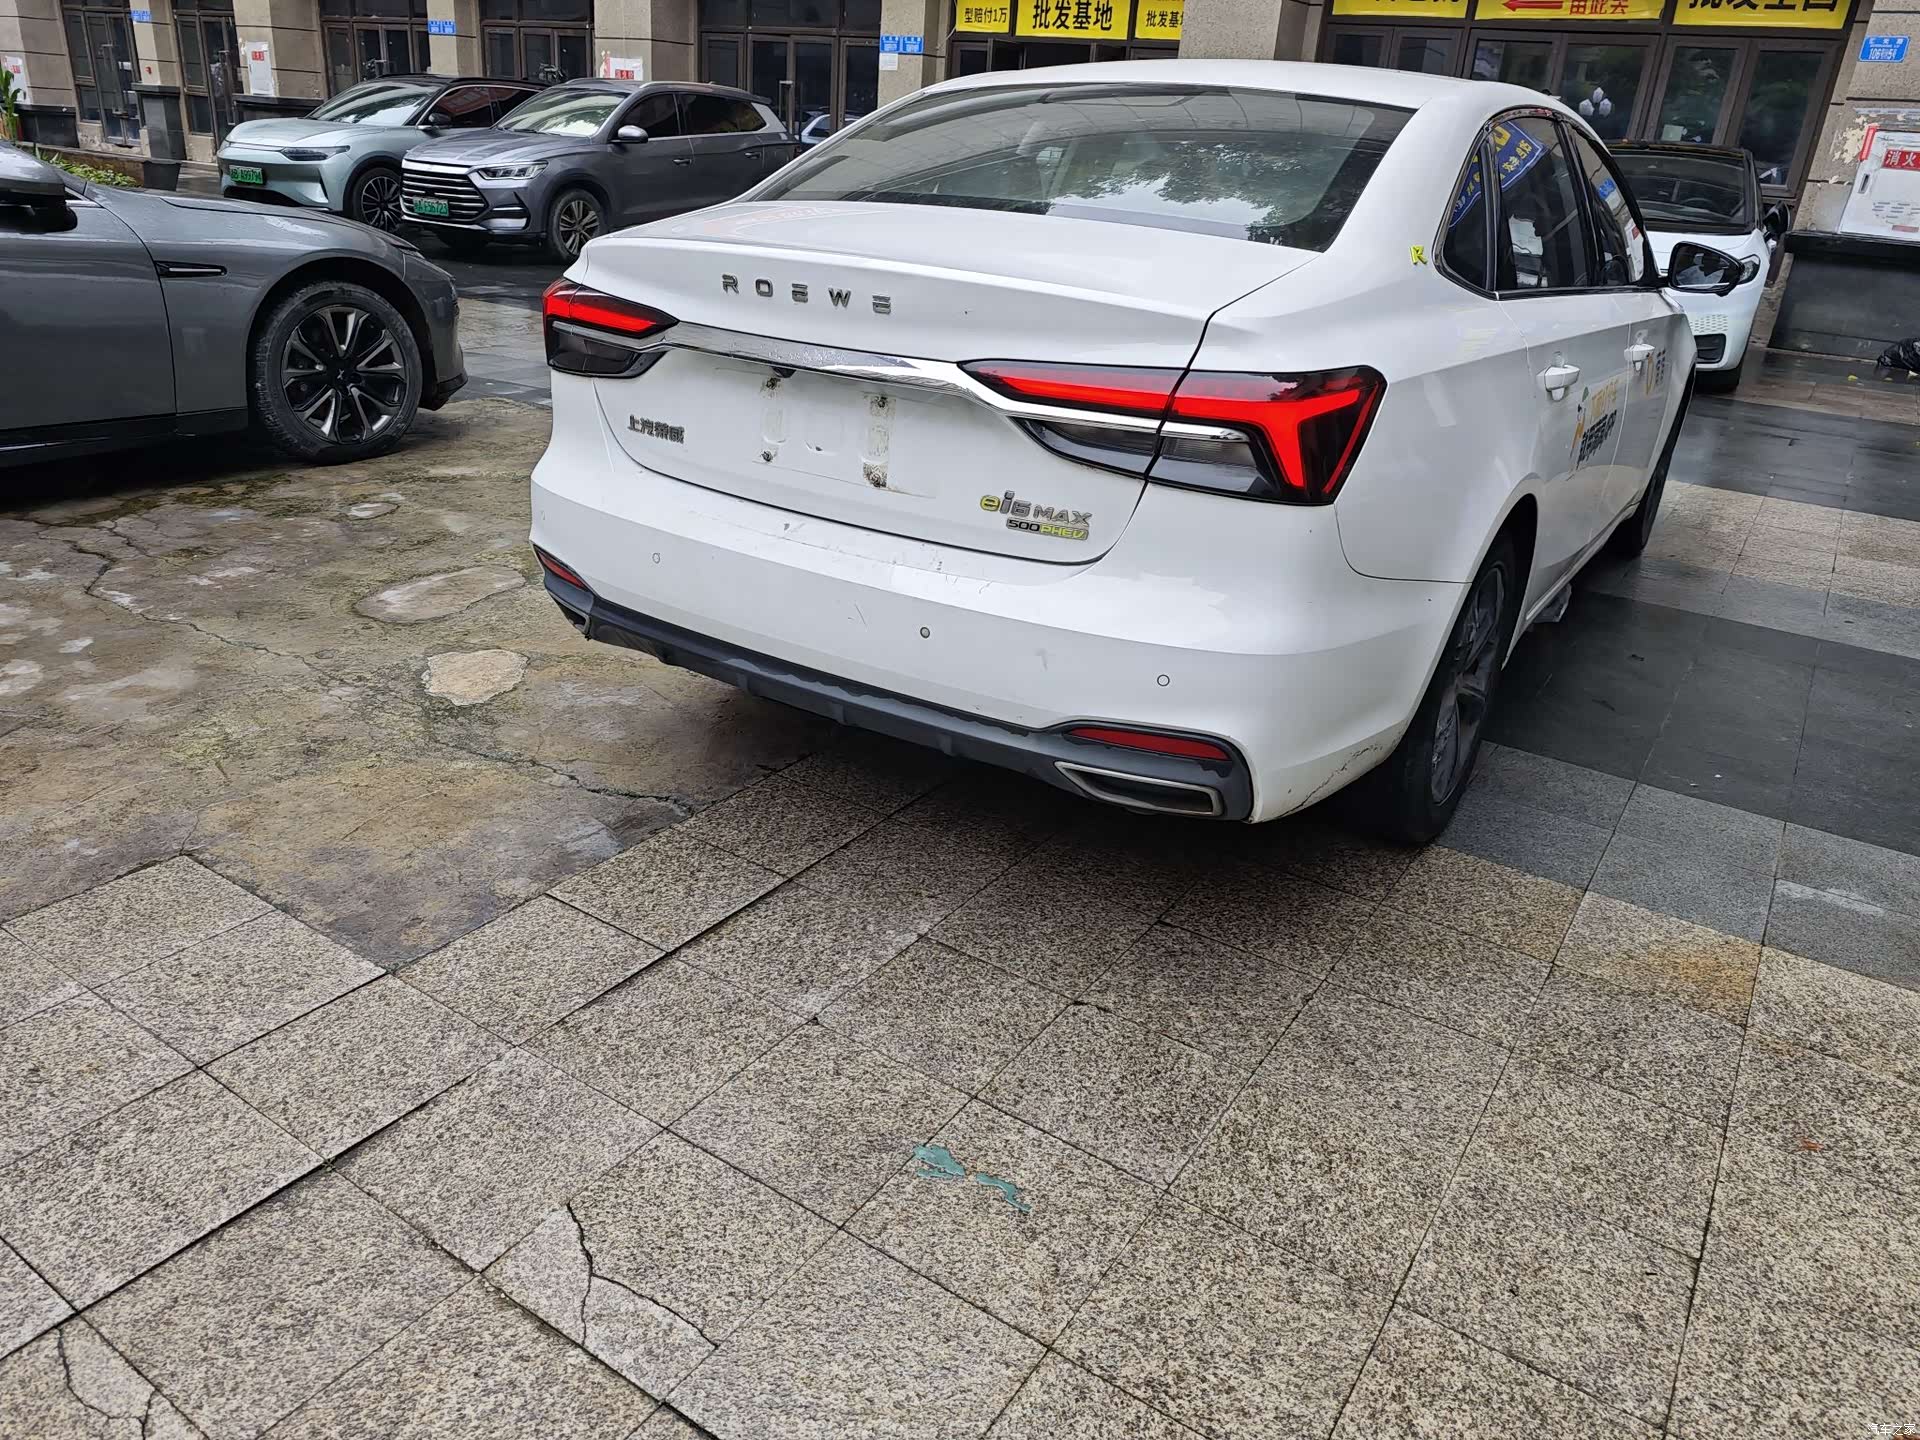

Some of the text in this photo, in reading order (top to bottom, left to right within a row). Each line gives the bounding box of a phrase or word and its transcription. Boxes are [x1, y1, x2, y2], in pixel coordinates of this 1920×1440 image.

[963, 7, 1008, 24] 型赔付1万
[1032, 0, 1113, 31] 批发基地
[1885, 150, 1920, 168] 消火
[722, 274, 892, 315] ROEWE
[627, 414, 685, 444] 上汽荣威
[980, 490, 1093, 526] ei6 MAX
